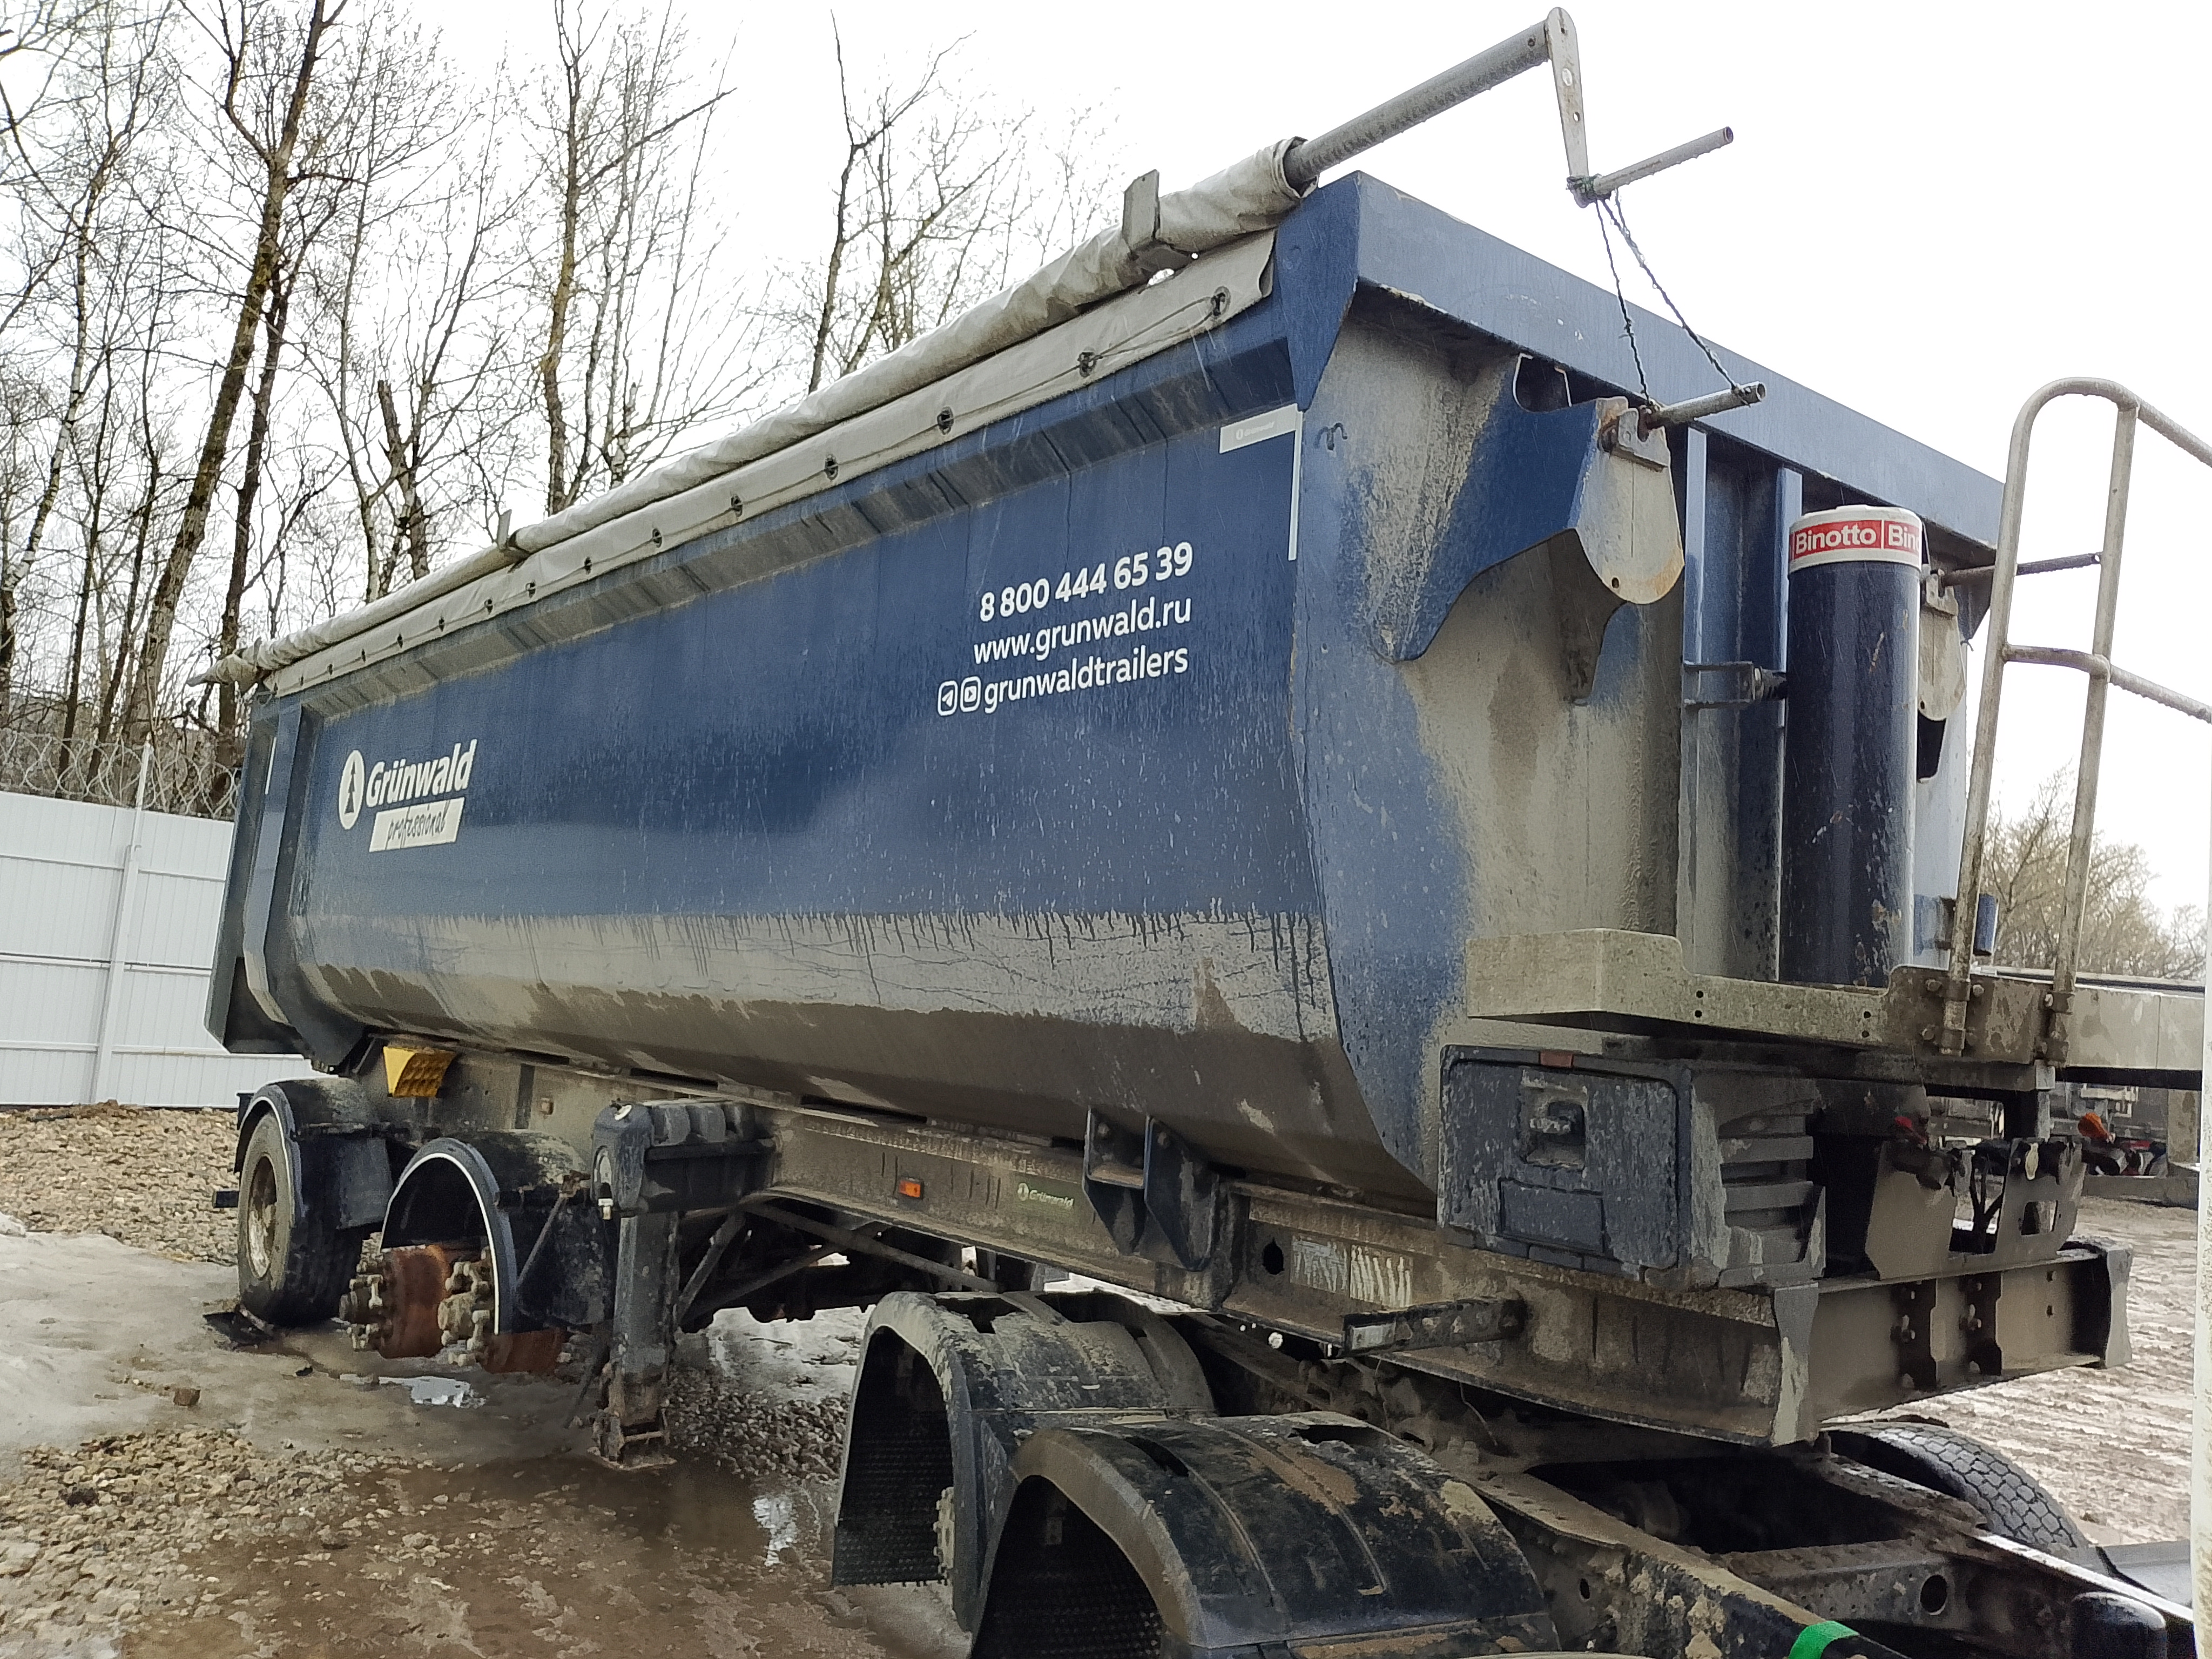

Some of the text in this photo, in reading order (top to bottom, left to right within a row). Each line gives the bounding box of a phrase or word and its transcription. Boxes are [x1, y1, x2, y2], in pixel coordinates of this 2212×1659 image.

[1796, 524, 1876, 554] Binotto
[980, 542, 1193, 622] 8 800 444 65 39
[974, 596, 1191, 664] www.grunwald.ru
[984, 645, 1188, 713] grunwaldtrailers
[366, 738, 477, 807] Grünwald
[385, 800, 450, 849] professional
